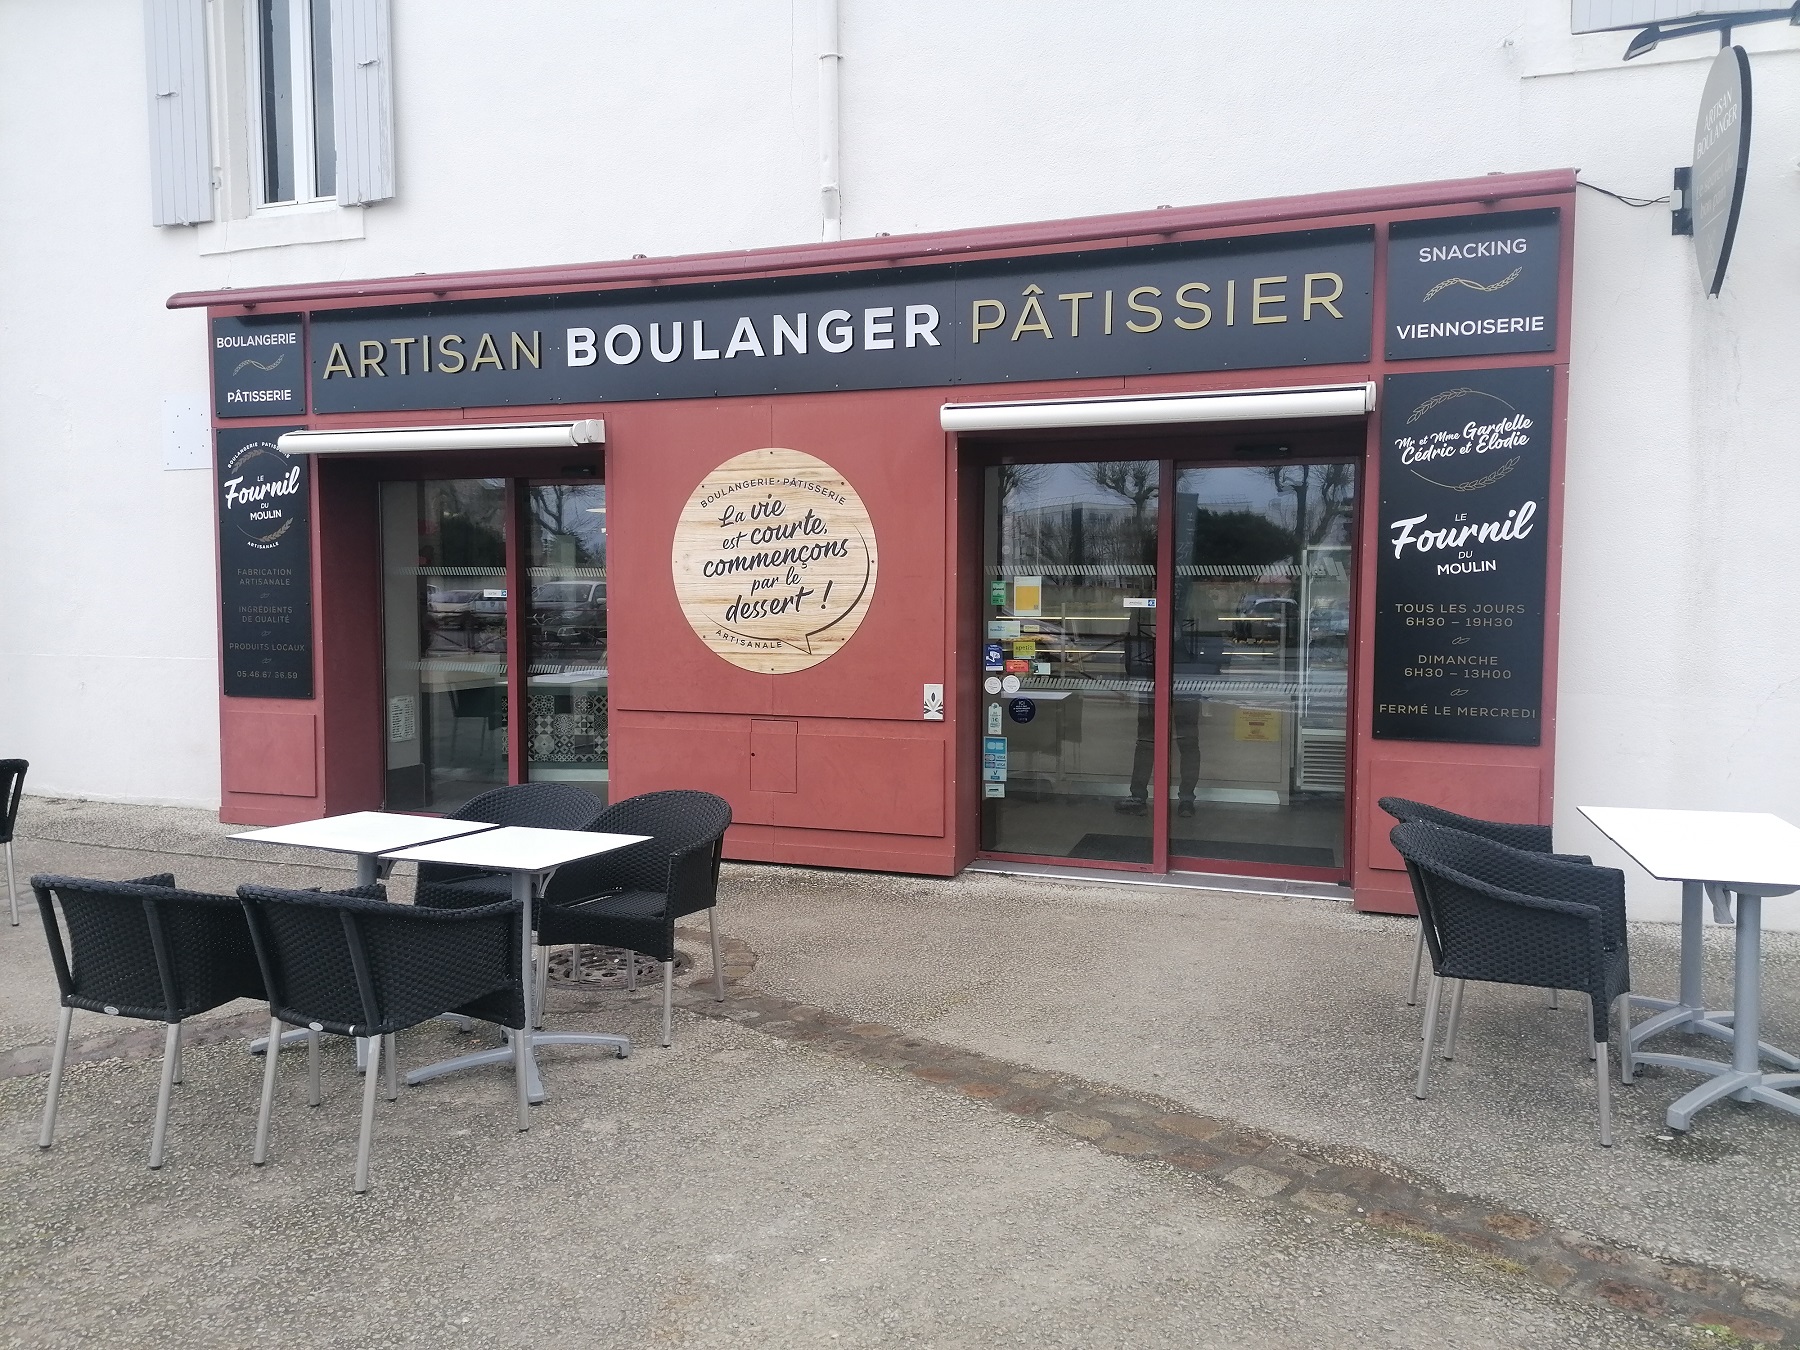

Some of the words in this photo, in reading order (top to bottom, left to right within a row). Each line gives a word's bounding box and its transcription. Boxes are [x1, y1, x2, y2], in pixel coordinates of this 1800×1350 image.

[1703, 87, 1733, 132] ARTISAN
[1696, 103, 1738, 160] BOULANGER
[1419, 238, 1527, 263] SNACKING
[322, 329, 542, 380] ARTISAN
[566, 303, 942, 368] BOULANGER
[971, 272, 1345, 344] PÂTISSIER
[1396, 316, 1544, 340] VIENNOISERIE
[216, 332, 297, 348] BOULANGERIE
[227, 388, 292, 403] PÂTISSERIE
[1395, 437, 1416, 450] Mr
[1419, 435, 1428, 446] et
[1430, 431, 1461, 443] Mme
[1462, 413, 1534, 440] Gardelle
[227, 442, 259, 469] BOULANGERIE
[261, 441, 291, 459] PATISSE
[1401, 443, 1457, 465] Cédric
[1459, 441, 1472, 455] et
[1475, 430, 1530, 453] Elodie
[224, 465, 301, 510] Fournil
[700, 477, 775, 508] BOULANGERIE
[783, 477, 847, 506] PÂTISSERIE
[250, 509, 282, 521] MOULIN
[718, 504, 746, 528] La
[750, 493, 787, 520] vie
[1454, 513, 1468, 522] LE
[722, 531, 748, 551] est
[750, 508, 828, 544] courte,
[1390, 501, 1537, 559] Fournil
[702, 538, 849, 578] commençons
[1458, 550, 1473, 559] DU
[237, 568, 292, 576] FABRICATION
[1437, 559, 1497, 576] MOULIN
[239, 578, 291, 586] ARTISANALE
[750, 575, 779, 597] par
[785, 565, 801, 586] le
[725, 586, 815, 624] dessert
[1395, 603, 1434, 614] TOUS
[1440, 603, 1467, 614] LES
[1472, 604, 1526, 614] JOURS
[242, 615, 253, 623] DE
[255, 613, 290, 624] QUALITÉ
[1405, 617, 1445, 627] 6H30
[1465, 617, 1513, 628] 19H30
[229, 642, 270, 651] PRODUITS
[271, 643, 305, 652] LOCAUX
[715, 629, 783, 649] ARTISANALE
[1418, 654, 1498, 666] DIMANCHE
[1404, 667, 1443, 678] 6H30
[1464, 669, 1512, 679] 13H00
[1379, 703, 1428, 715] FERMÉ
[1434, 705, 1451, 716] LE
[1457, 706, 1536, 719] MERCREDI
